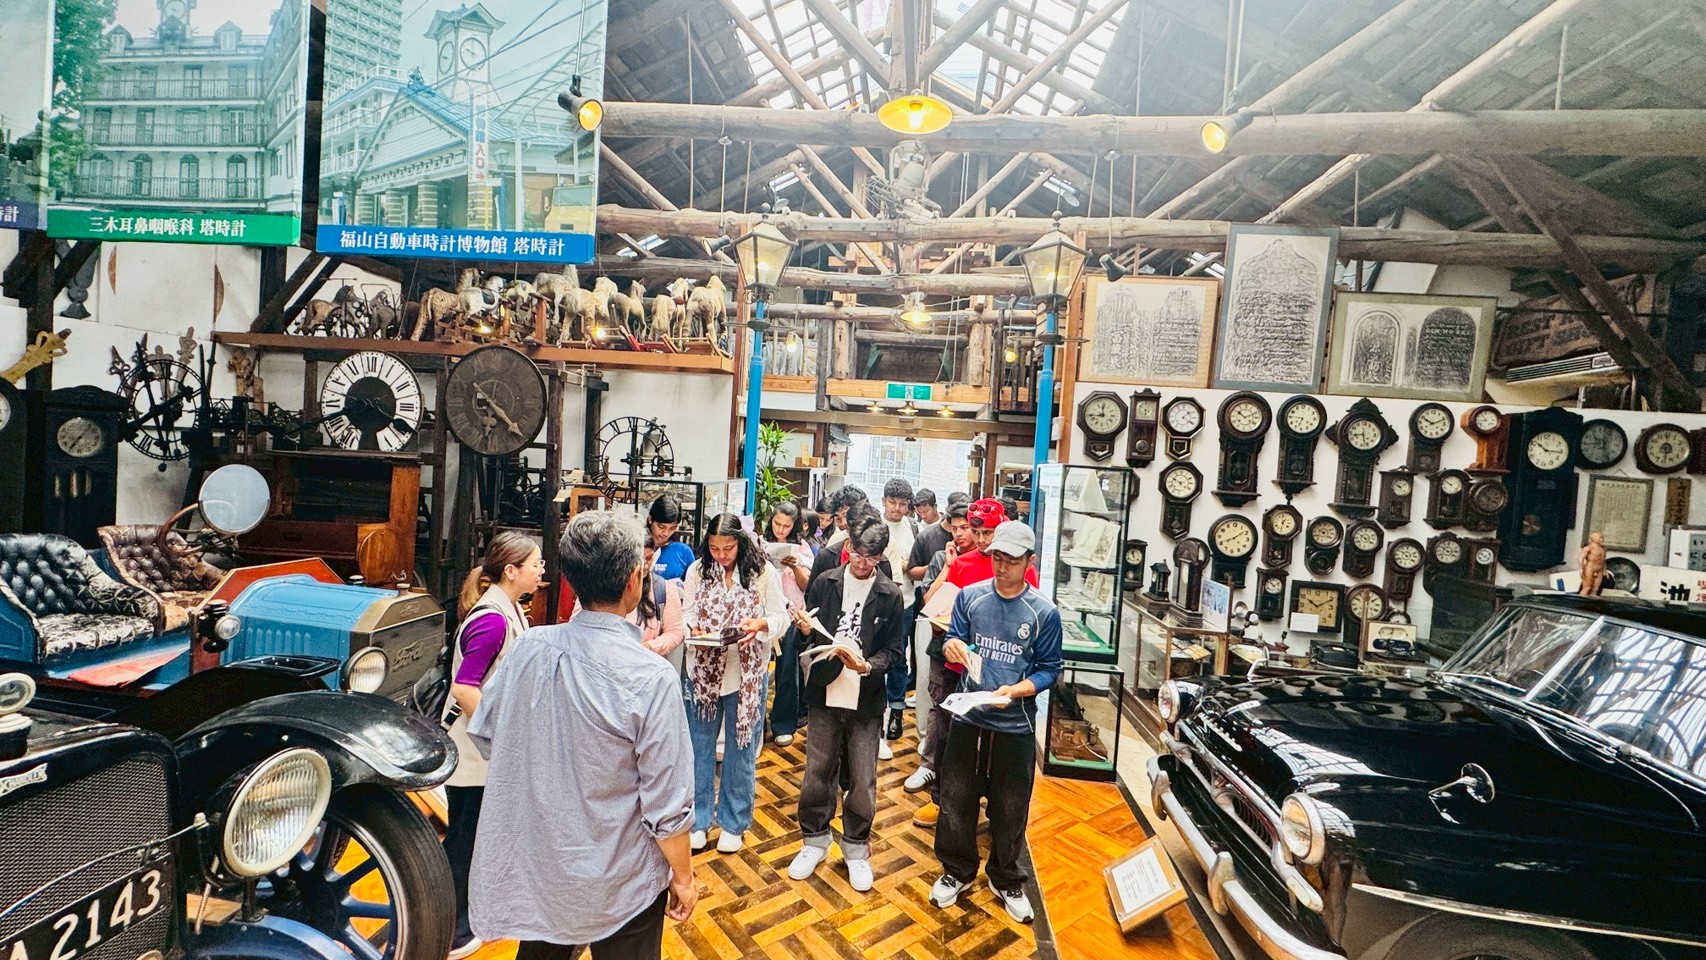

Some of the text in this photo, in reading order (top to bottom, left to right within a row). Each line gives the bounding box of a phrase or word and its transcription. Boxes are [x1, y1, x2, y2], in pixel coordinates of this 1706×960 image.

[89, 216, 247, 237] 三木耳鼻咽喉科 塔時計
[340, 230, 566, 257] 福山自動車時計博物館 塔時計
[975, 632, 1024, 655] Emirates
[979, 647, 1016, 664] FLY BETTER
[393, 641, 425, 672] Ford
[50, 869, 161, 960] 2143
